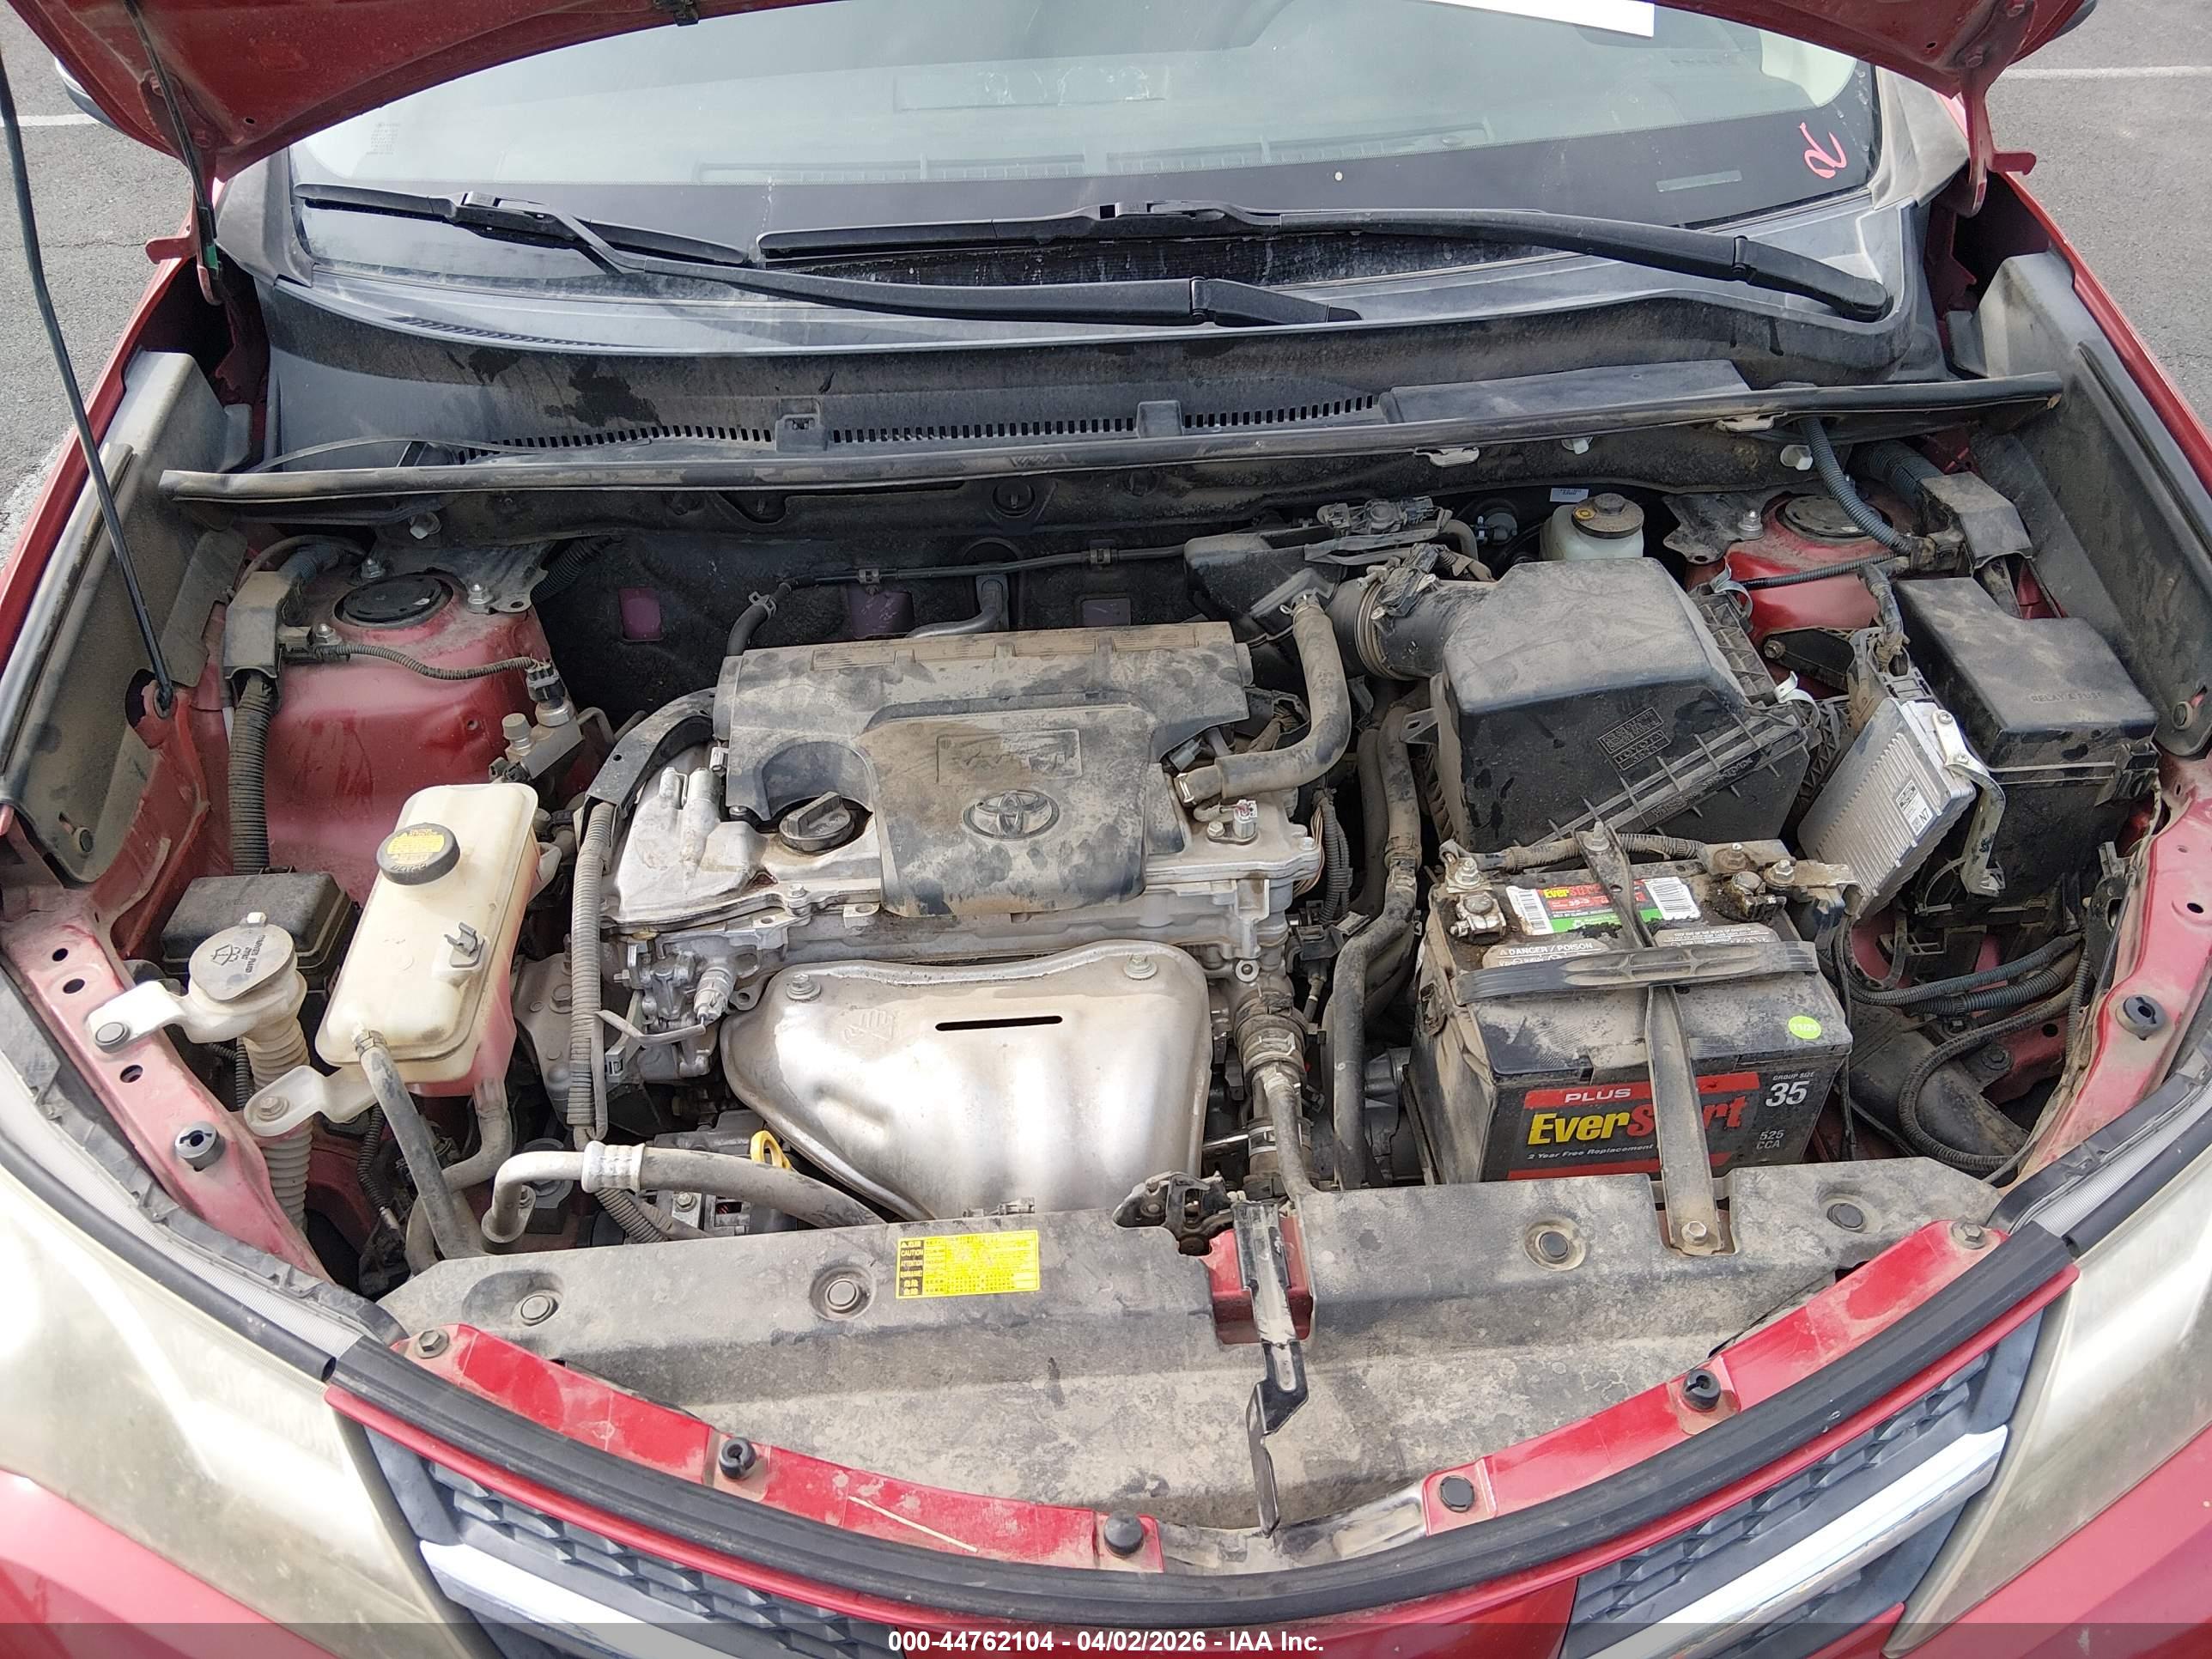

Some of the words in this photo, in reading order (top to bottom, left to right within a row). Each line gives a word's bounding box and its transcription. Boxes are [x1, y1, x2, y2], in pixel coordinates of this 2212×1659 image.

[1509, 946, 1547, 956] DANGER
[1557, 942, 1594, 951] POISON
[1564, 1087, 1632, 1103] PLUS
[1765, 1080, 1810, 1107] 35
[1527, 1096, 1748, 1146] EverSrt
[1759, 1129, 1785, 1140] 525
[1587, 1144, 1655, 1155] Replacement
[1756, 1139, 1781, 1150] CCA
